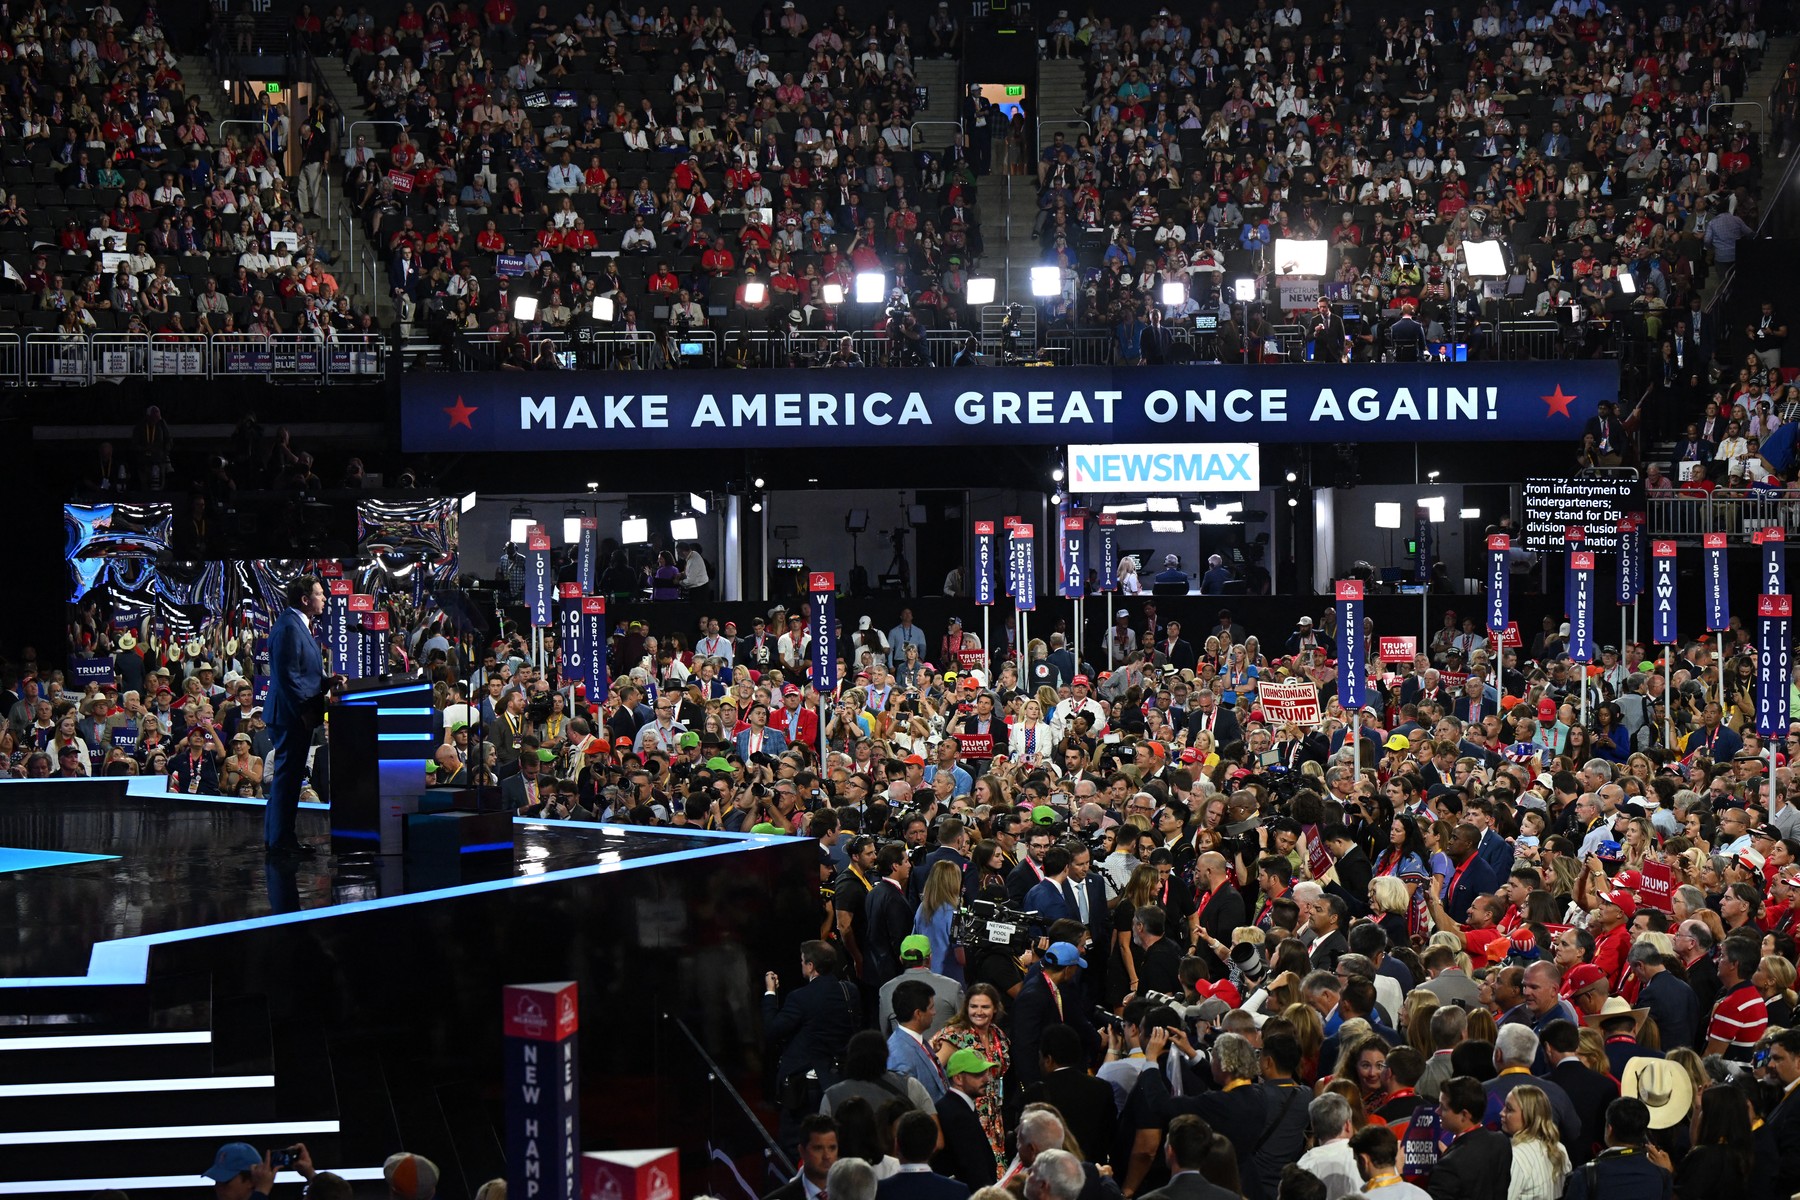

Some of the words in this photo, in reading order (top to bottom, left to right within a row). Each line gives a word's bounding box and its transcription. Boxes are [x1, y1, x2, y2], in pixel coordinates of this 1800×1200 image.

[527, 97, 547, 107] BLUE
[500, 258, 524, 267] TRUMP
[1280, 286, 1319, 294] SPECTRUM
[1289, 294, 1319, 302] NEWS
[275, 360, 296, 369] BLUE
[521, 394, 668, 429] MAKE
[691, 392, 932, 427] AMERICA
[955, 390, 1122, 424] GREAT
[1143, 388, 1287, 423] ONCE
[1310, 387, 1497, 421] AGAIN!
[1076, 453, 1252, 482] NEWSMAX
[1526, 484, 1550, 493] from
[1553, 484, 1617, 497] infantrymen
[1619, 485, 1631, 495] to
[1526, 496, 1612, 509] kindergarteners;
[1526, 509, 1552, 521] They
[1554, 510, 1583, 520] stand
[1586, 510, 1602, 520] for
[1603, 511, 1622, 520] DEI
[1526, 522, 1566, 532] division
[1526, 535, 1546, 545] and
[980, 536, 989, 601] MARYLAND
[1017, 543, 1026, 603] NORTHERN
[1069, 539, 1080, 587] UTAH
[1622, 533, 1631, 601] COLORADO
[536, 553, 546, 623] LOUISIANA
[1494, 553, 1503, 626] MICHIGAN
[1656, 560, 1673, 637] HAWAII
[1712, 550, 1721, 626] MISSISSIPPI
[1577, 572, 1587, 657] MINNESOTA
[337, 597, 348, 671] MISSOURI
[569, 610, 581, 667] OHIO
[591, 615, 599, 647] NORTH
[816, 594, 830, 686] WISCONSIN
[1382, 642, 1413, 650] TRUMP
[1346, 602, 1356, 704] PENNSYLVANIA
[76, 666, 111, 675] TRUMP
[592, 650, 600, 699] CAROLINA
[1440, 674, 1466, 682] RUMP
[1761, 620, 1771, 729] FLORIDA
[1778, 620, 1788, 729] FLORIDA
[1263, 687, 1312, 699] JOHNSTONIANS
[1266, 706, 1315, 721] TRUMP
[1641, 875, 1669, 892] TRUMP
[989, 923, 1013, 931] NETWORK
[522, 1043, 541, 1105] NEW
[564, 1041, 573, 1103] NEW
[1416, 1115, 1434, 1127] STOP
[525, 1117, 541, 1199] HAMP
[1405, 1153, 1438, 1165] LOODBATH
[1406, 1140, 1433, 1153] BORDER
